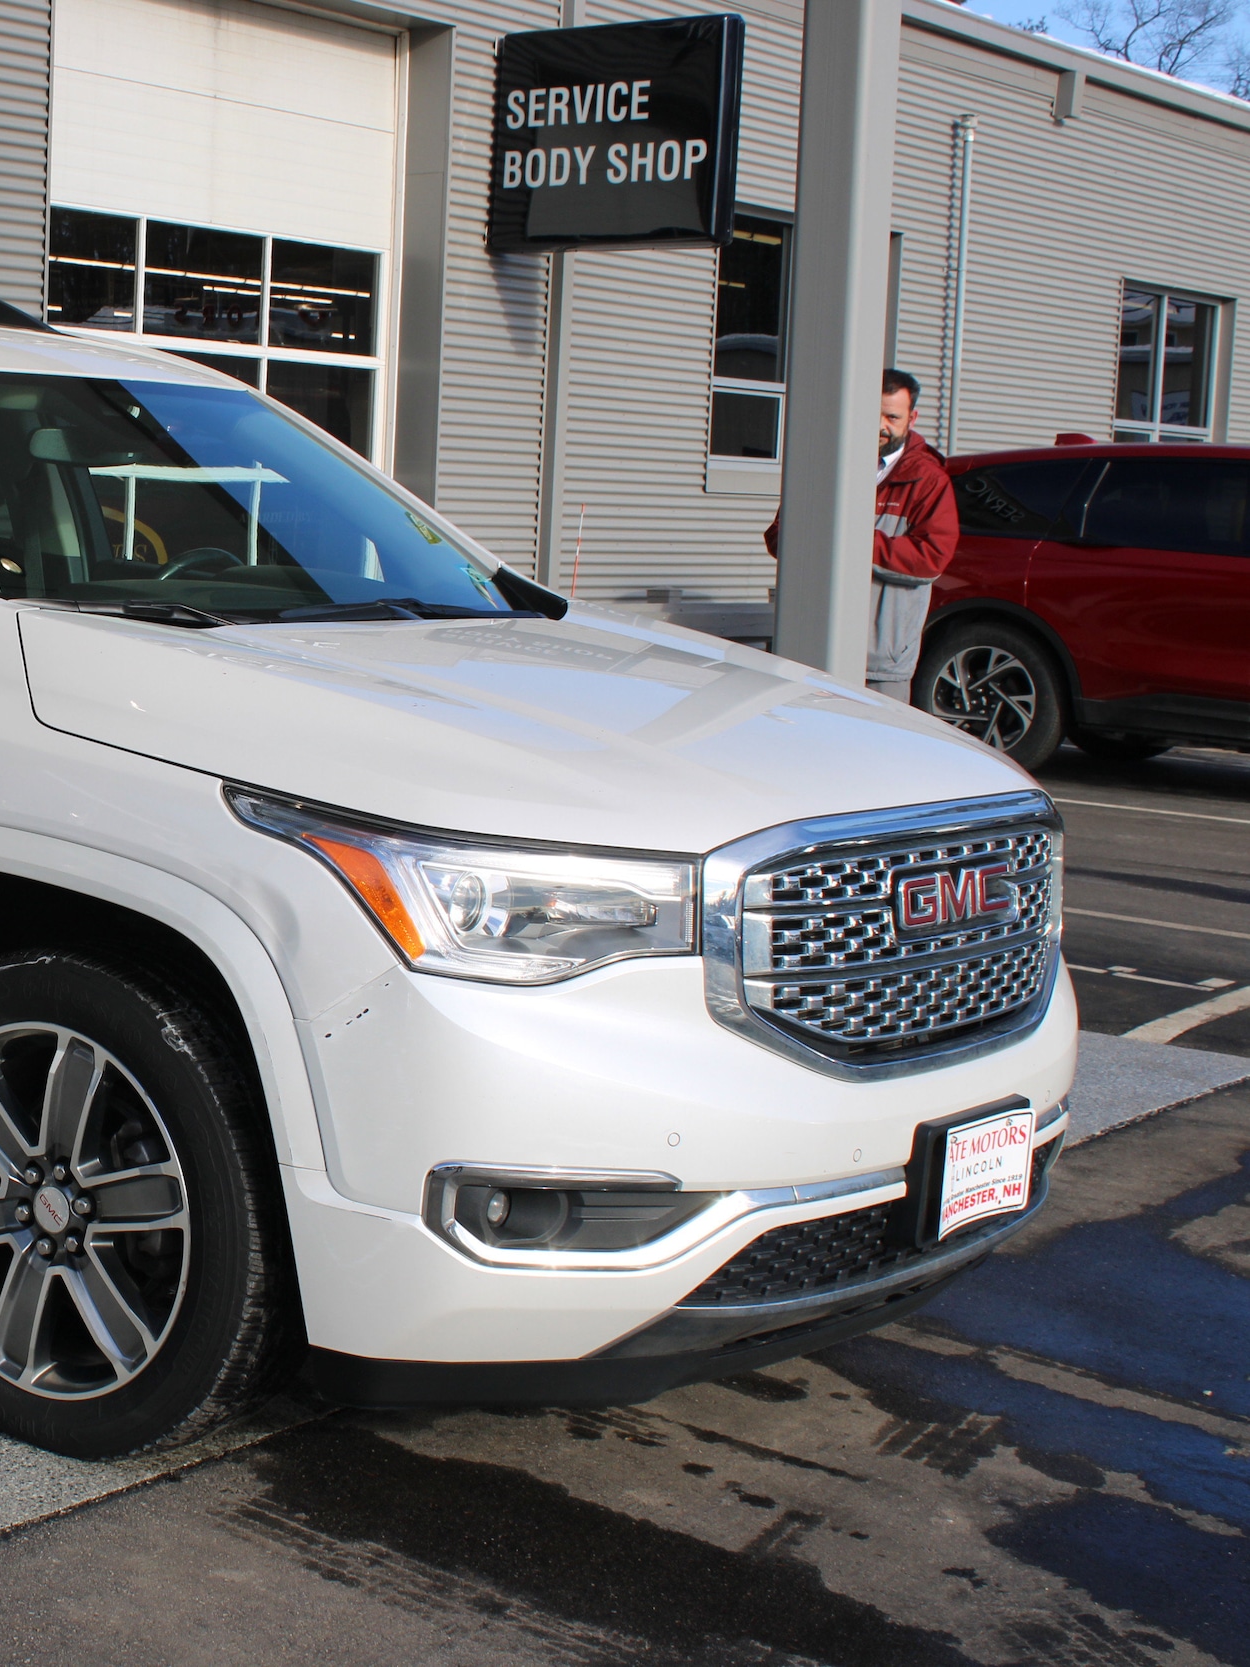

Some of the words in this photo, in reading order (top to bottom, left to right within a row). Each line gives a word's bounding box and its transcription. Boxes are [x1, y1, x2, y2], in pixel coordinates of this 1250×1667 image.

[506, 80, 651, 129] SERVICE
[502, 145, 596, 189] BODY
[606, 139, 707, 184] SHOP
[899, 862, 1012, 930] GMC
[948, 1140, 968, 1165] ATE
[969, 1124, 1027, 1157] MOTORS
[955, 1155, 1003, 1181] LINCOLN
[39, 1193, 64, 1227] GMC
[1002, 1182, 1022, 1199] NH
